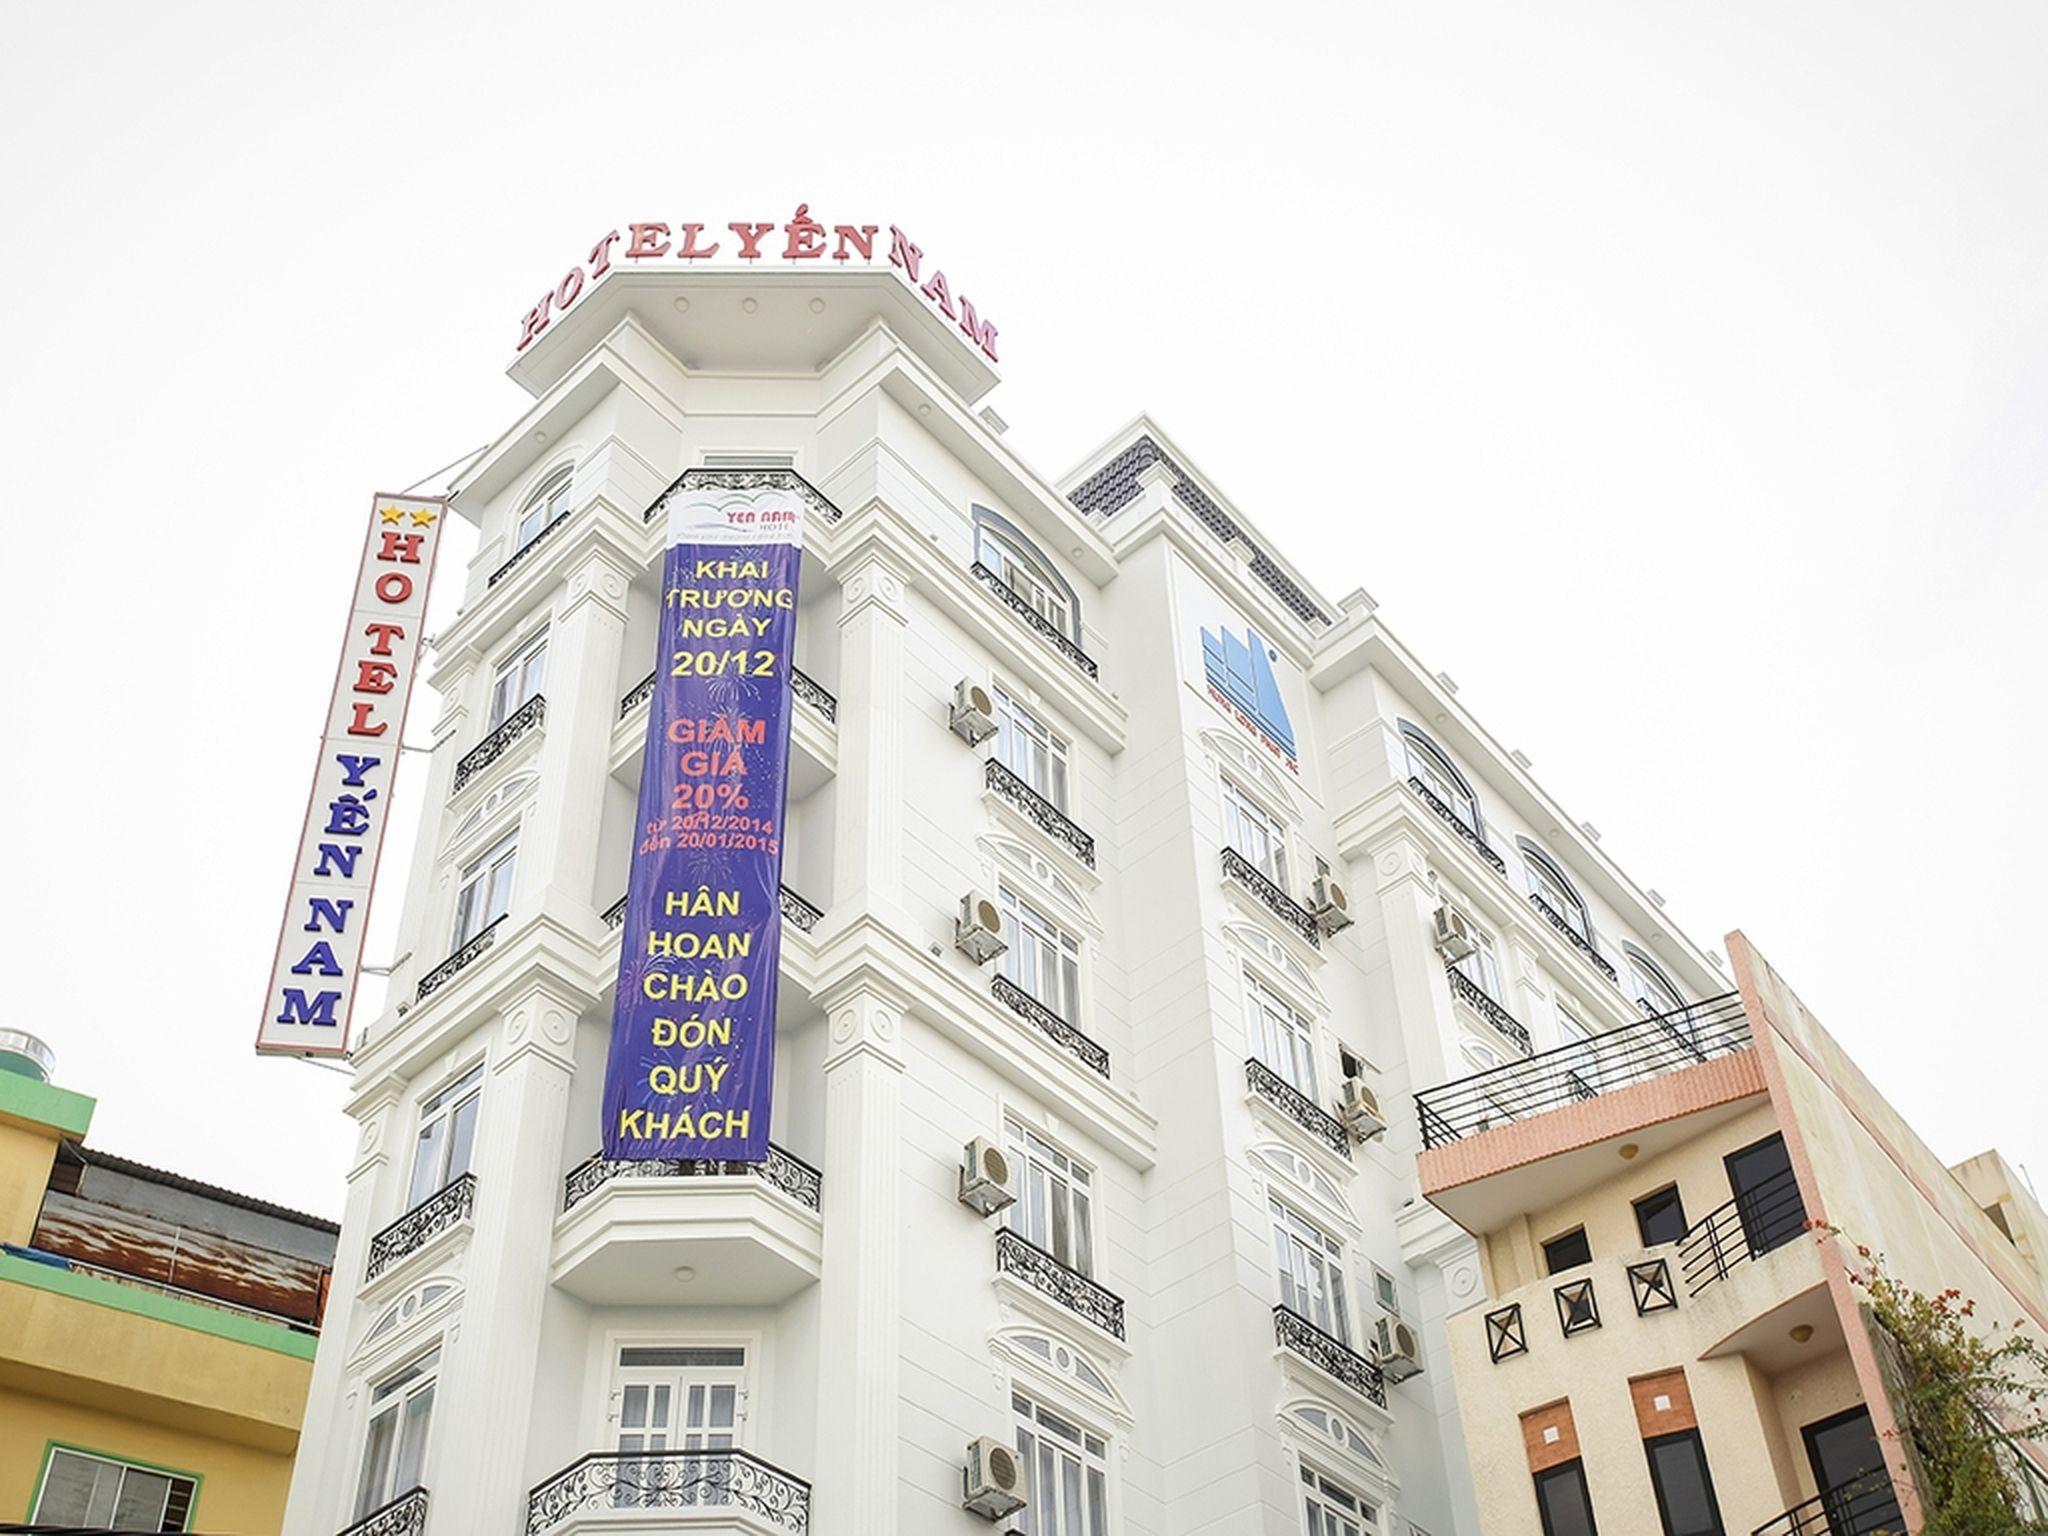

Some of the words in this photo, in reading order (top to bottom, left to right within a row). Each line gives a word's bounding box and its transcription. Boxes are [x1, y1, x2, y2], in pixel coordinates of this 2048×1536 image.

[515, 222, 720, 352] HOTEL
[888, 224, 999, 363] NAM
[695, 560, 769, 579] KHAI
[347, 531, 425, 737] HOTEL
[681, 613, 772, 638] NGÀY
[671, 650, 776, 677] 20/12
[680, 743, 749, 777] GIÁ
[672, 783, 750, 810] 20%
[314, 754, 381, 879] YẾN
[672, 814, 774, 835] 20/12/2014
[677, 832, 779, 856] 20/01/2015
[665, 885, 740, 917] HÂN
[647, 931, 751, 959] HOAN
[277, 898, 354, 1027] NAM
[643, 969, 749, 1002] CHÀO
[652, 1012, 732, 1048] ĐÓN
[650, 1056, 729, 1095] QUÝ
[619, 1104, 750, 1140] KHÁCH
